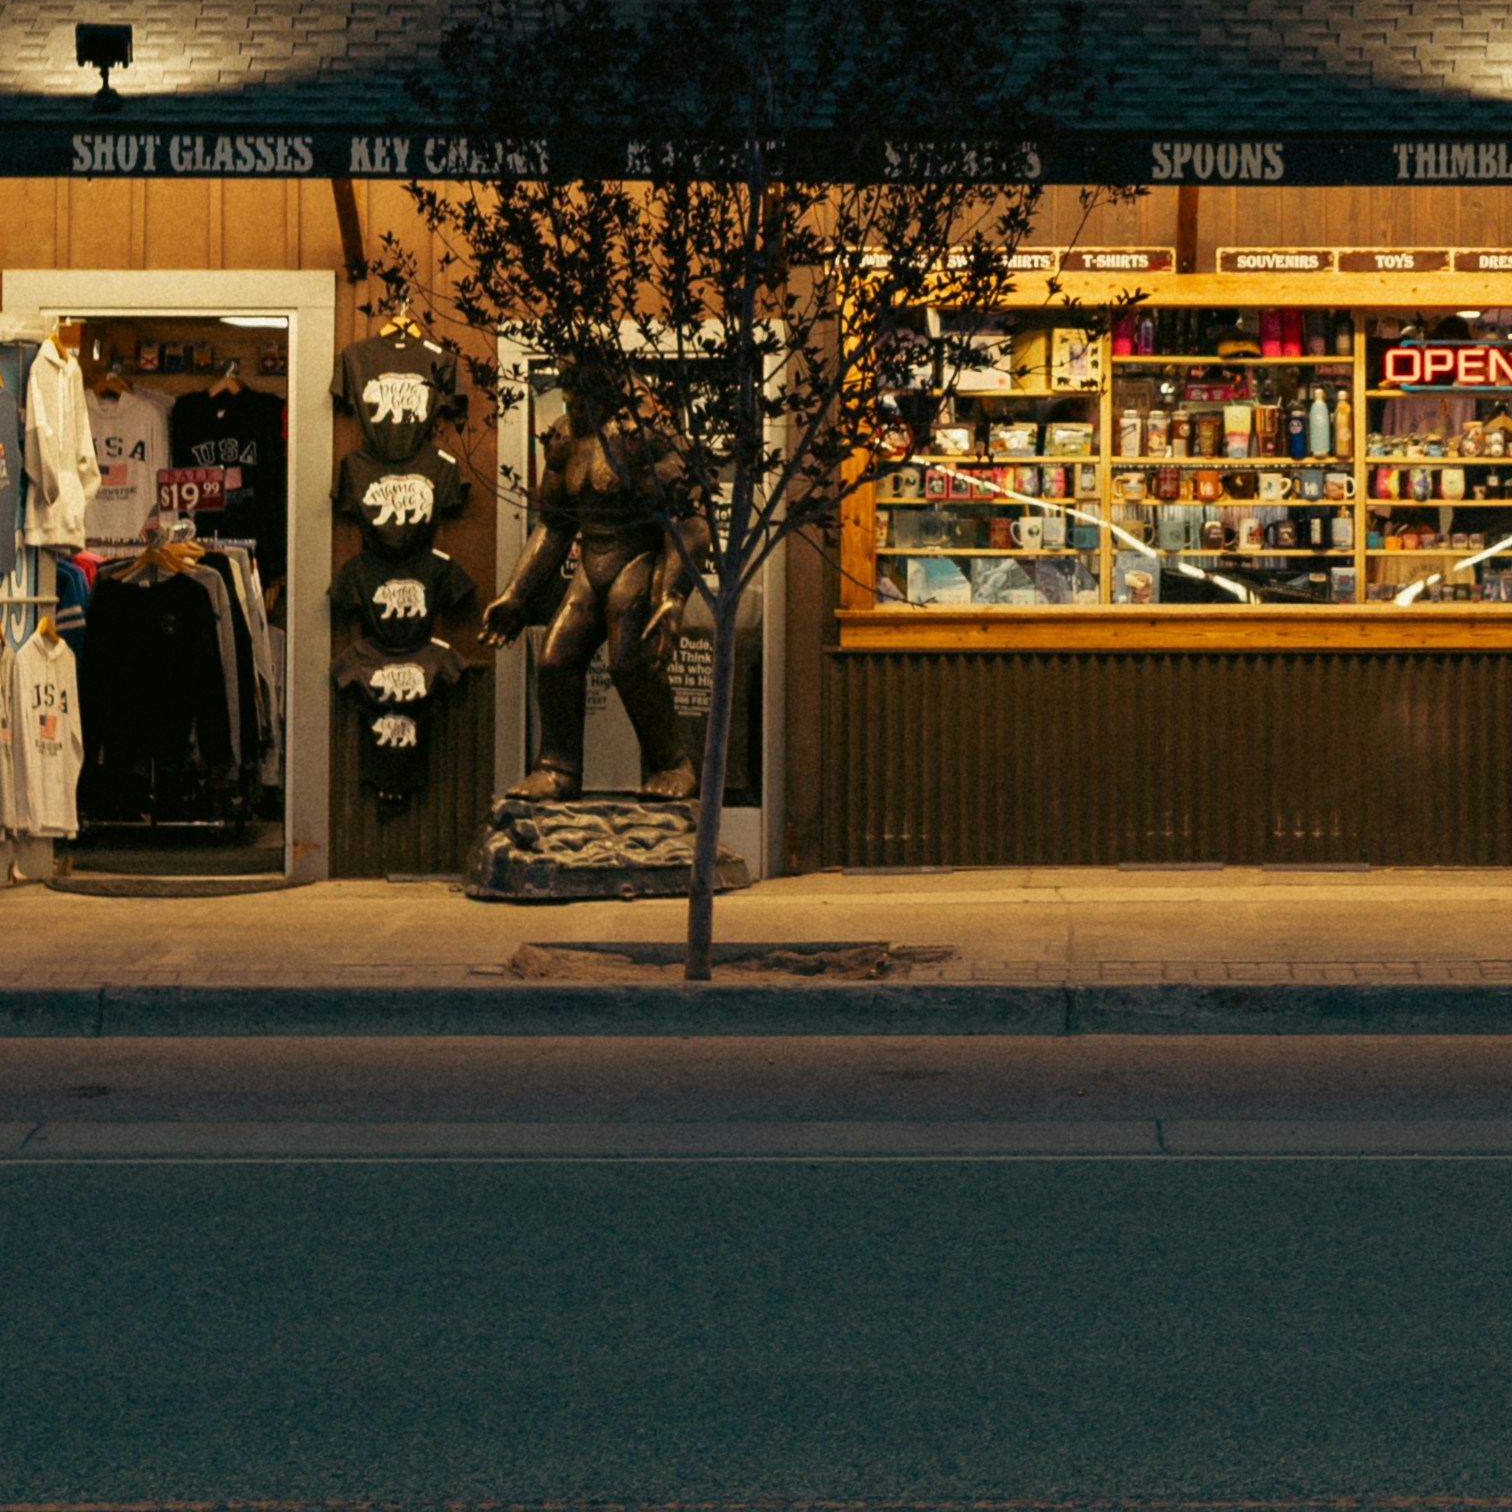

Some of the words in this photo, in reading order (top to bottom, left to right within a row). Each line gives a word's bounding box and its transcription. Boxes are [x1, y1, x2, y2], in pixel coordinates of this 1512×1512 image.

[71, 134, 162, 174] SHOT
[170, 135, 314, 174] GLASSES
[349, 136, 411, 174] KEY
[1150, 141, 1285, 181] SPOONS
[1082, 253, 1150, 269] T-SHIRTS
[1236, 253, 1320, 270] SOUVENIRS
[1374, 253, 1415, 270] TOYS
[93, 436, 147, 462] SA
[191, 437, 259, 467] USA
[167, 469, 214, 482] SALE
[160, 481, 200, 510] $19
[203, 480, 221, 495] 99
[679, 635, 713, 651] Dude,
[681, 650, 713, 662] Think
[687, 662, 713, 675] who
